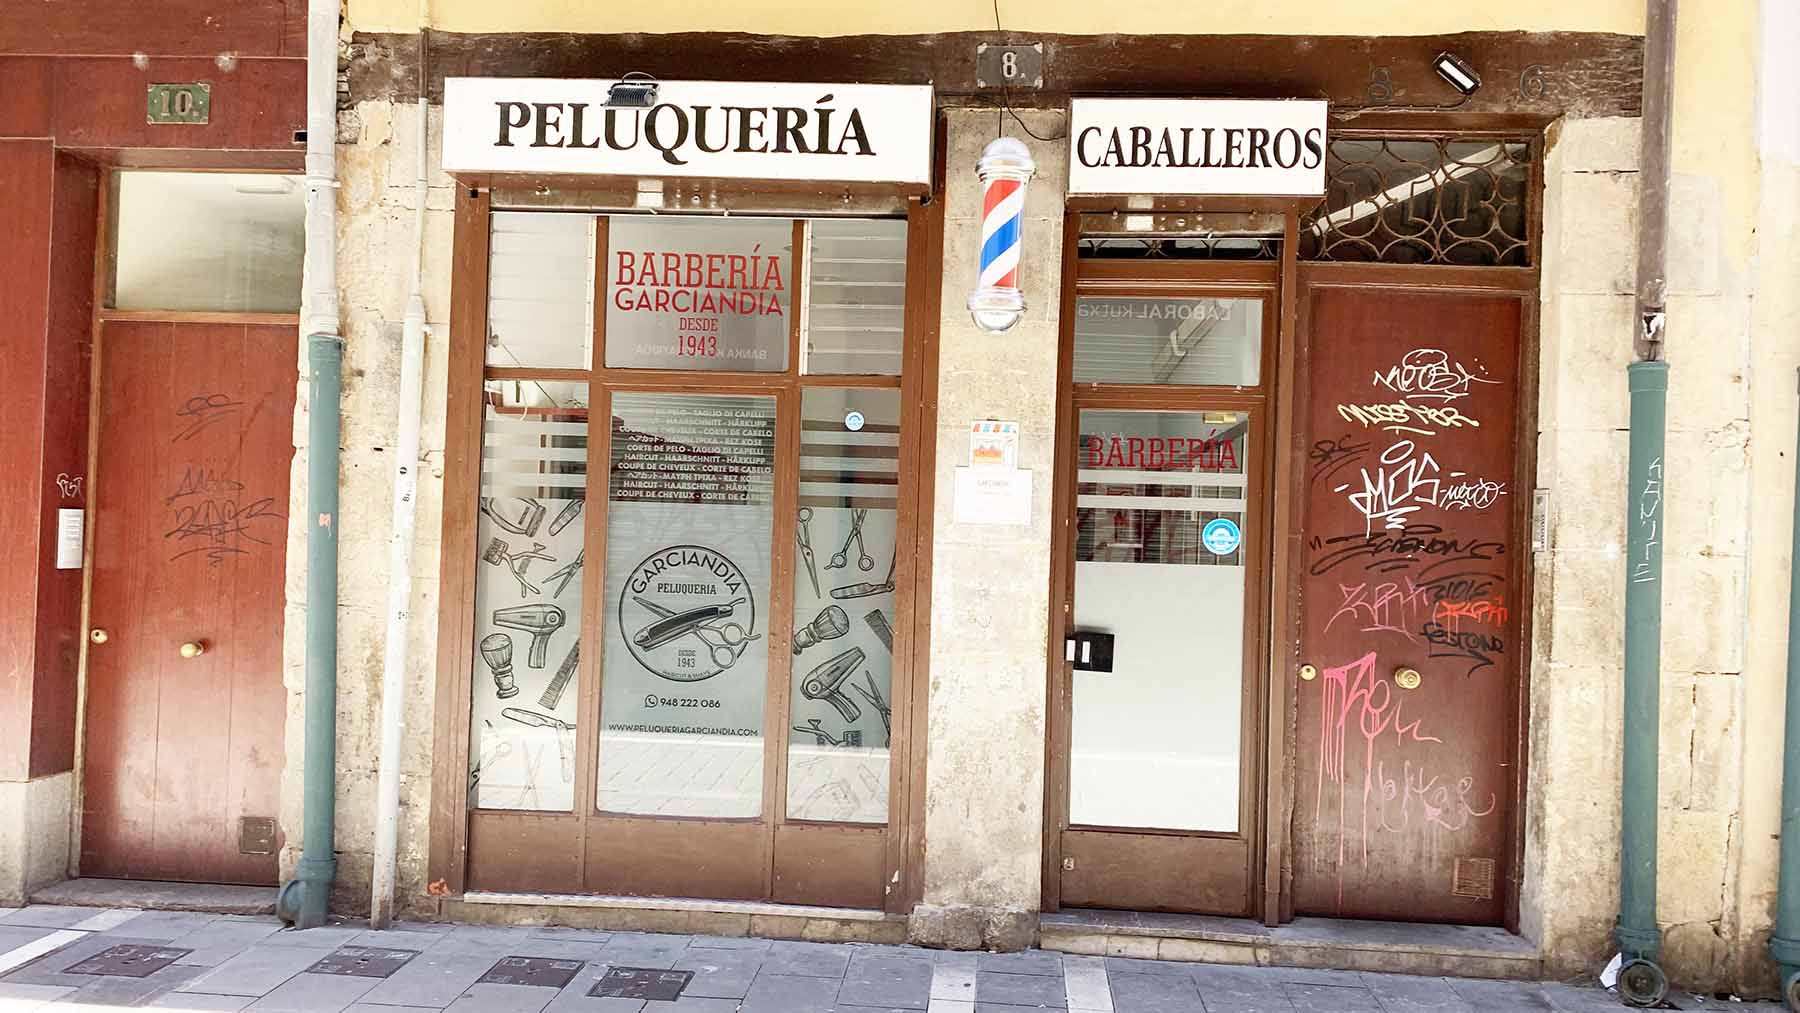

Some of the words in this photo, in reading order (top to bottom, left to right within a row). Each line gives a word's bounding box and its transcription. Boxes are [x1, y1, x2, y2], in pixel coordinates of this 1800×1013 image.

[494, 92, 877, 166] PELUQUERÍA
[1077, 125, 1323, 170] CABALLEROS
[616, 243, 785, 291] BARBERÍA
[615, 287, 784, 317] GARCIANDIA
[679, 317, 719, 332] DESDE
[677, 335, 718, 356] 1943
[626, 444, 652, 452] CORTE
[666, 445, 687, 453] PELO
[692, 446, 720, 454] TAGLIO
[1087, 428, 1239, 469] BARBERÍA
[624, 453, 659, 461] HAIRCUT
[665, 454, 720, 463] HAARSCHNITT
[617, 462, 645, 470] COUPE
[658, 463, 696, 471] CHEVEUX
[702, 464, 727, 473] CORTE
[728, 465, 740, 473] DE
[740, 466, 772, 474] CABELO
[623, 480, 658, 489] HAIRCUT
[664, 481, 720, 491] HAARSCHNITT
[616, 490, 644, 498] COUPE
[657, 491, 695, 500] CHEVEUX
[701, 492, 726, 501] CORTE
[728, 493, 739, 501] DE
[631, 550, 743, 596] GARCIANDIA
[677, 657, 696, 668] 1943
[660, 698, 679, 707] 948
[680, 699, 699, 708] 222
[700, 700, 721, 708] 086
